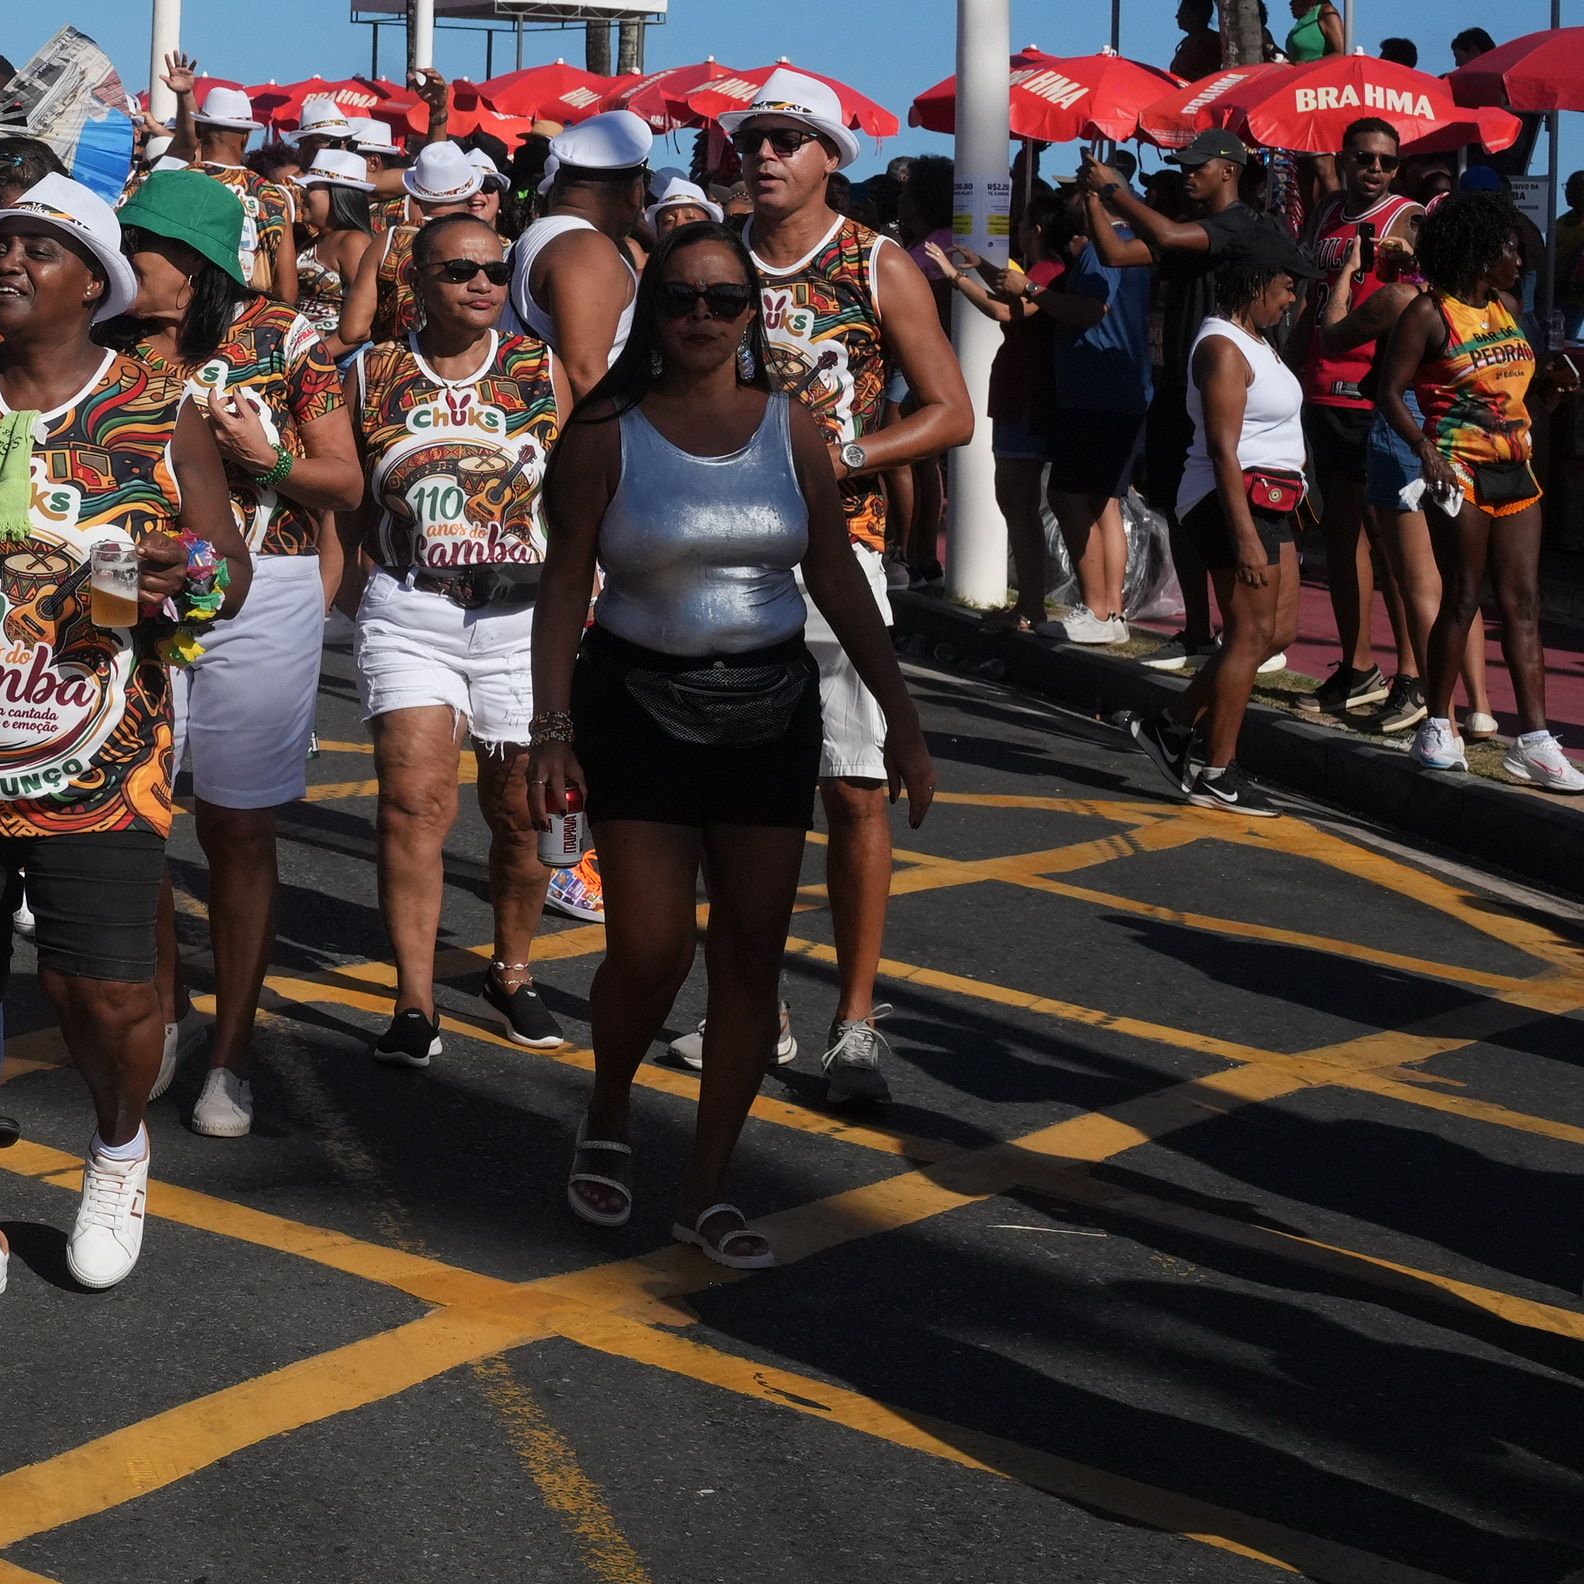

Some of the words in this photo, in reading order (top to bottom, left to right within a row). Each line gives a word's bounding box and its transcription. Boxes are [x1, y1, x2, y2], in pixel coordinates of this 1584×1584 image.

[1181, 73, 1249, 115] BRAHMA
[1295, 82, 1436, 121] BRAHMA
[1468, 338, 1535, 369] PEDRÃO
[414, 485, 464, 521] 110
[426, 523, 467, 538] anos
[470, 525, 488, 538] do
[6, 642, 33, 665] do
[3, 719, 10, 728] e
[12, 718, 59, 734] emoção
[8, 705, 59, 721] cantada
[563, 814, 577, 854] ITAIPAVA
